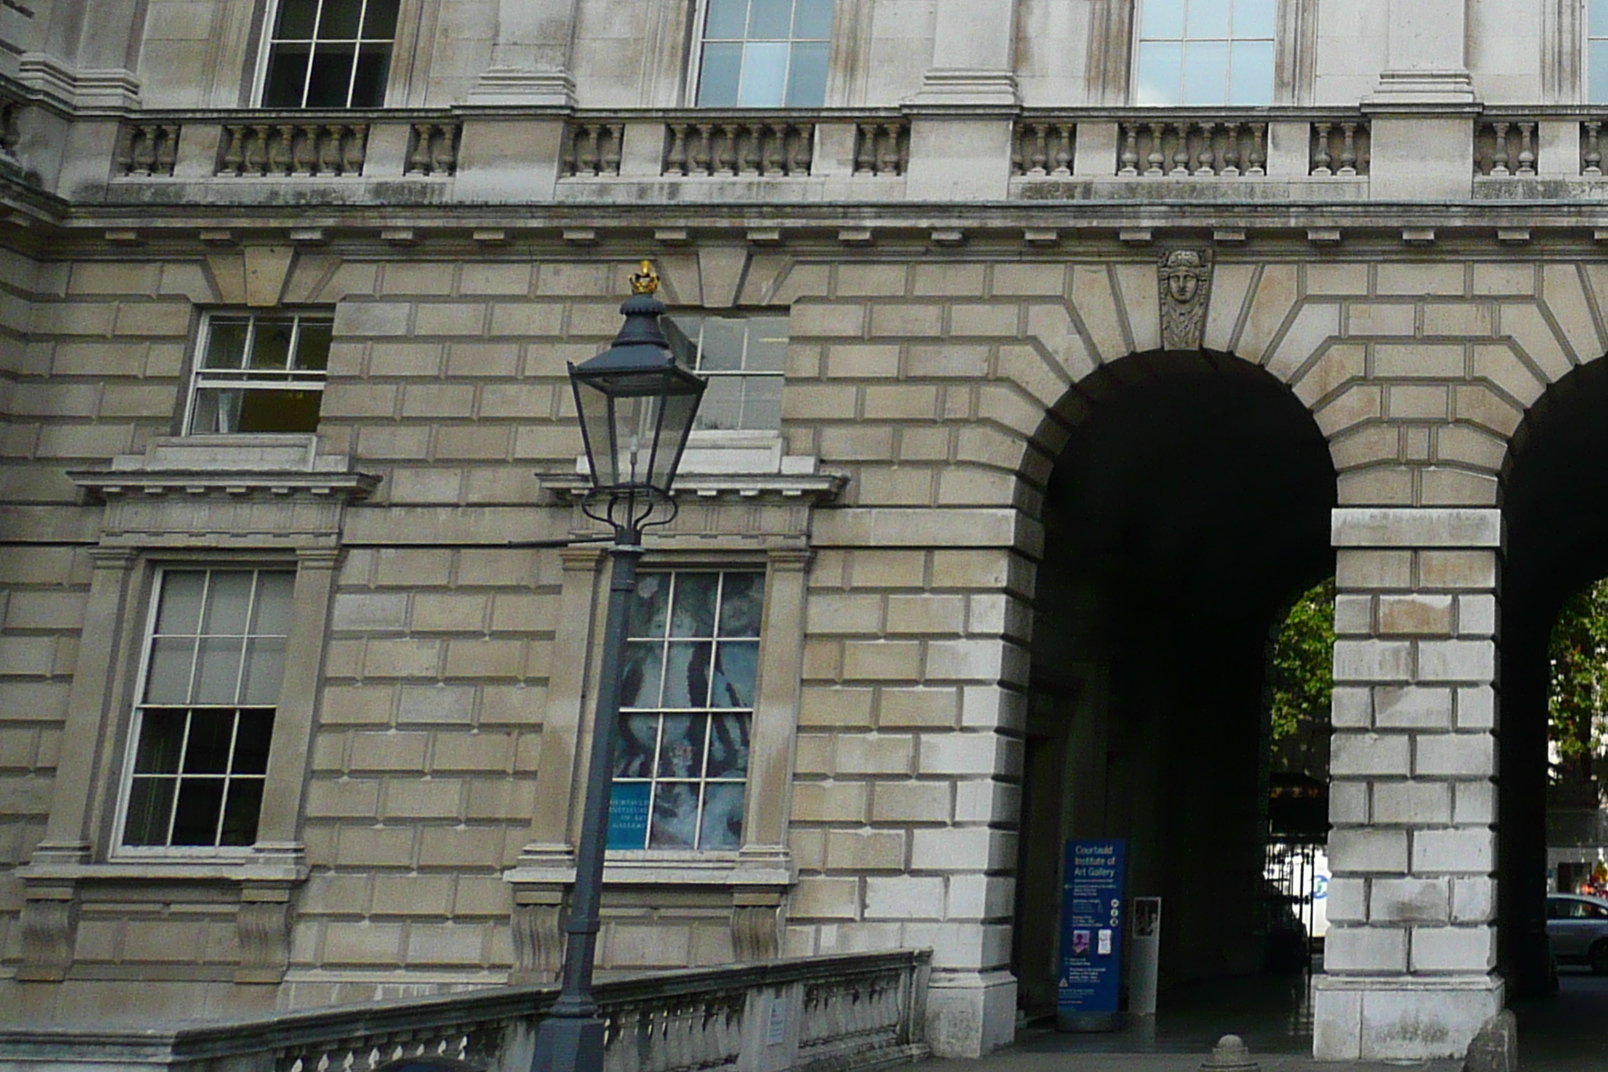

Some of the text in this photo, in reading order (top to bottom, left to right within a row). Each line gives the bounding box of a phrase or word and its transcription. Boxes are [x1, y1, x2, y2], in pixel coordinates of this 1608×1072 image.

[1075, 845, 1113, 855] Courtauld
[1074, 856, 1116, 866] Institute of
[1074, 867, 1115, 878] Art Gallery
